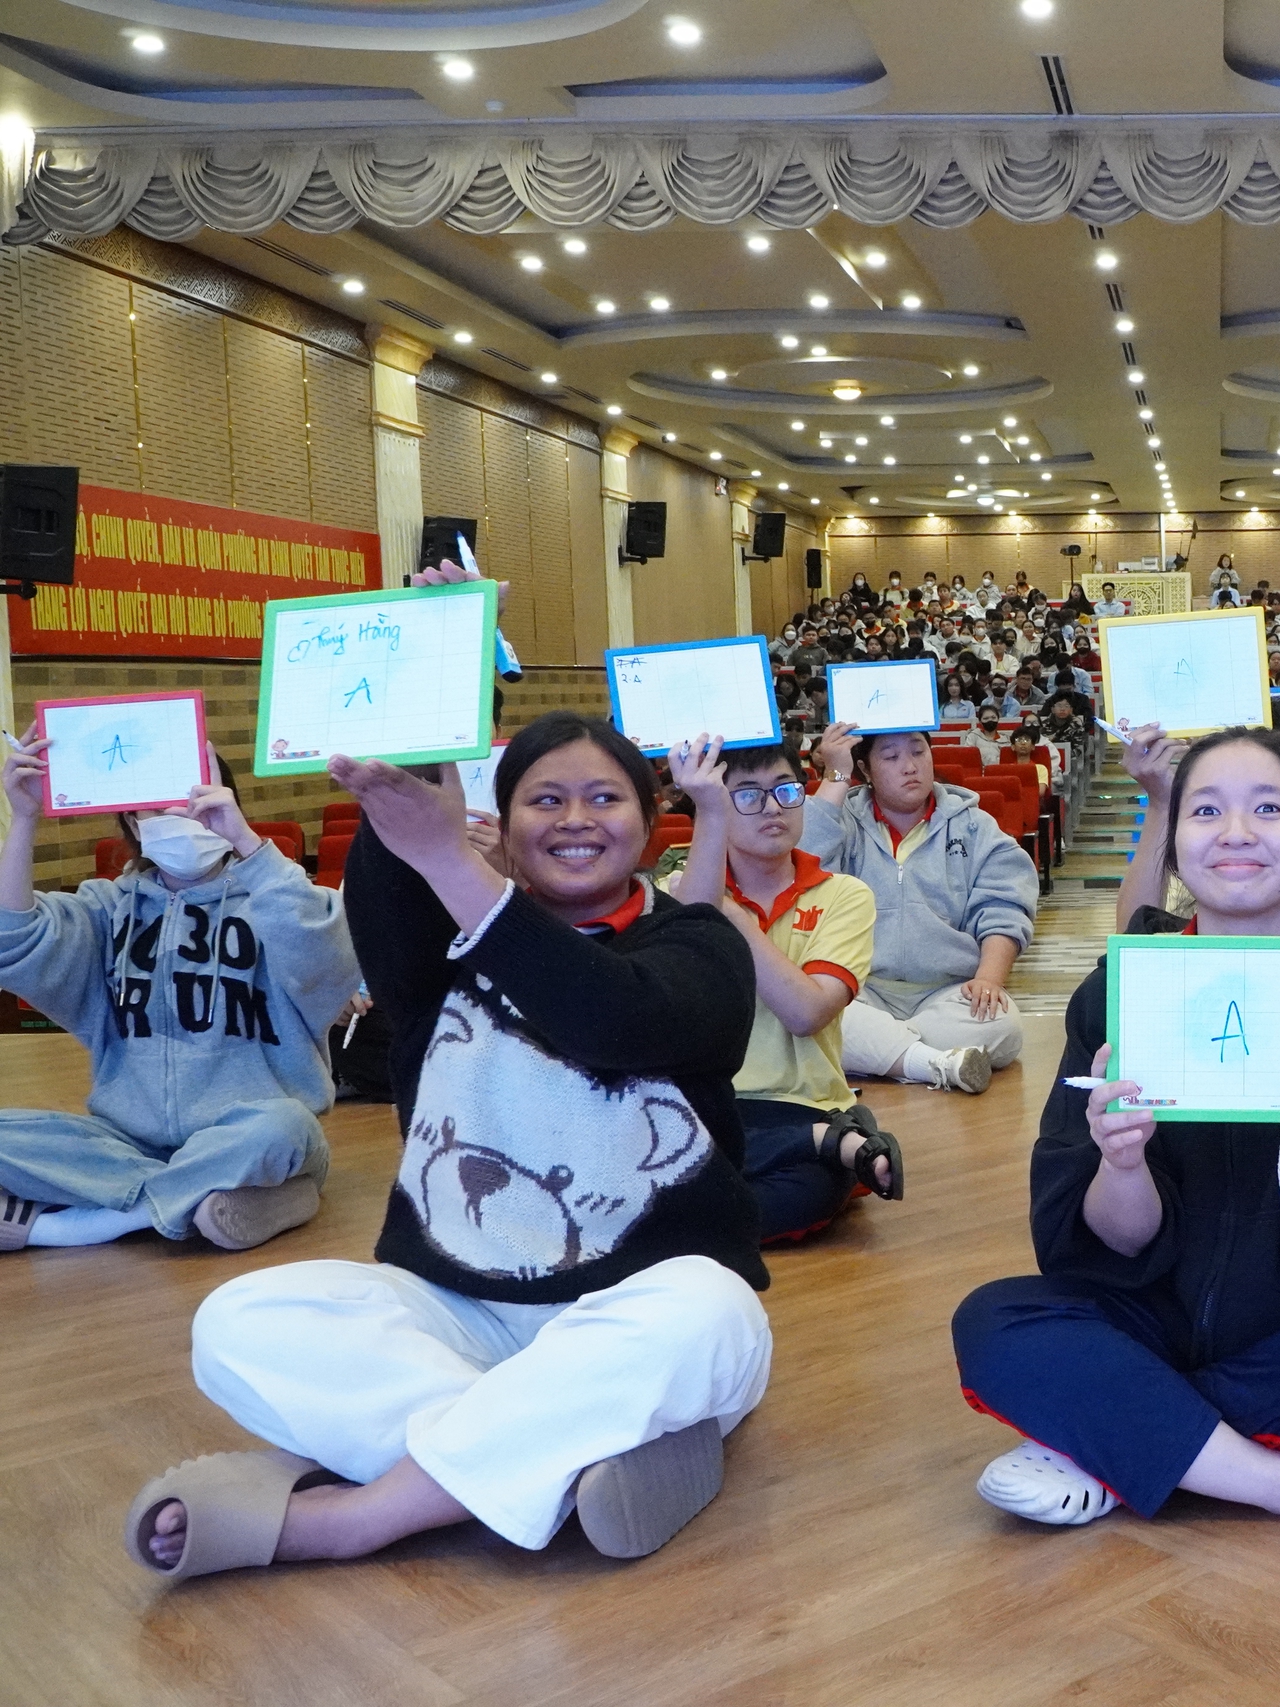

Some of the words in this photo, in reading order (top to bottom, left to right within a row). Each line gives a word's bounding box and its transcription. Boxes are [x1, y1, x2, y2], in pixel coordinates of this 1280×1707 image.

[92, 508, 126, 560] CHÍNH
[127, 507, 162, 568] QUYỀN,
[162, 517, 182, 566] DÂN
[182, 521, 197, 568] VÀ
[197, 524, 222, 573] QUÂN
[222, 529, 258, 575] PHƯỜNG
[291, 533, 314, 582] QUYẾT
[69, 581, 88, 640] LỢI
[88, 588, 117, 641] NGHỊ
[117, 578, 149, 638] QUYẾT
[169, 588, 187, 643] HỘI
[344, 677, 373, 708] A
[867, 689, 886, 709] A
[102, 734, 142, 771] A
[468, 766, 484, 788] A
[1211, 1000, 1250, 1064] A
